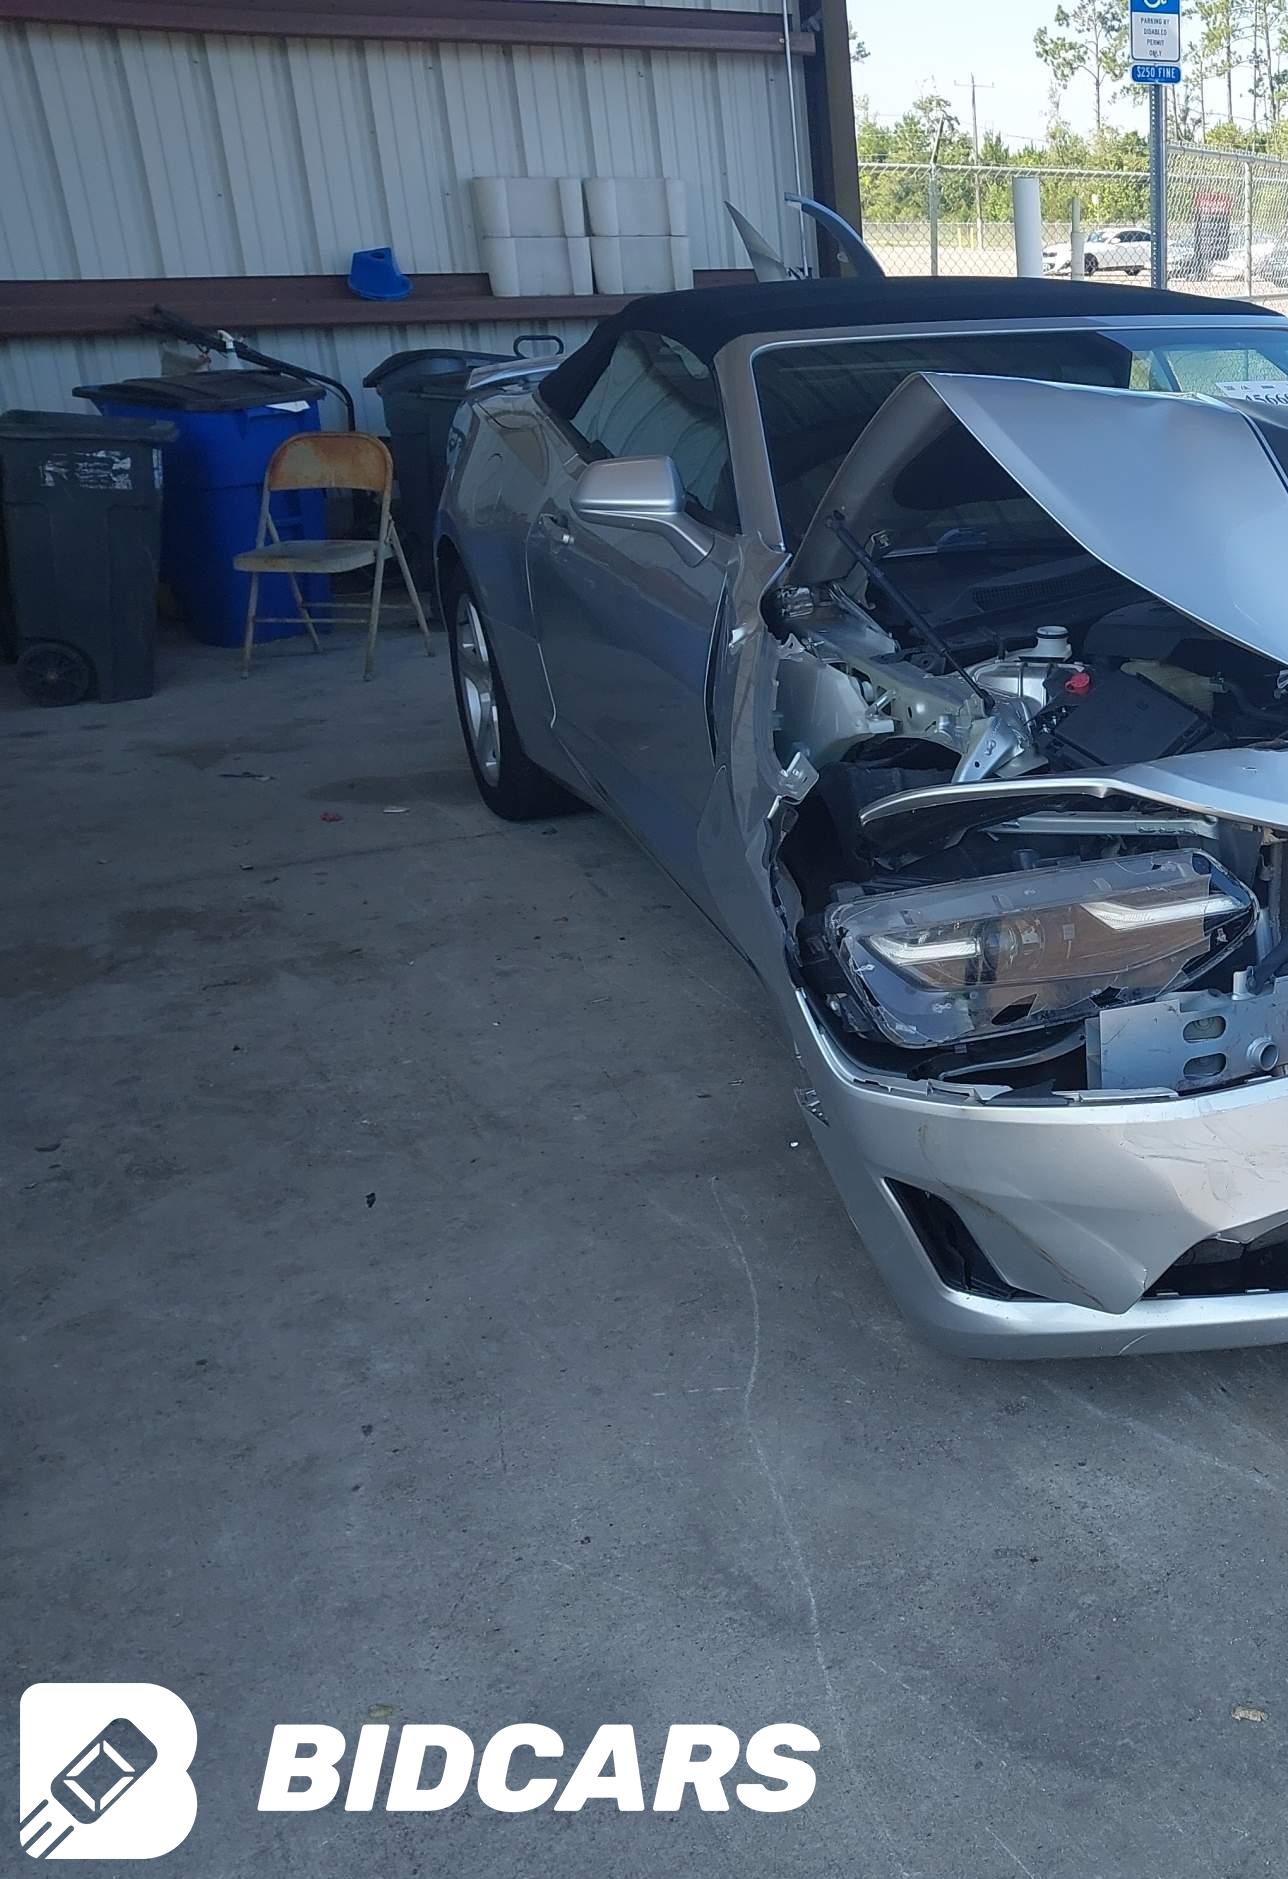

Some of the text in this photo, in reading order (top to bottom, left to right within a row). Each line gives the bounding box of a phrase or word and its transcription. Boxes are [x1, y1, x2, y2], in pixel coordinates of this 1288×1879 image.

[1143, 28, 1167, 36] DISABLED
[1146, 38, 1164, 46] PERMIT
[1148, 49, 1162, 57] ONLY
[1136, 66, 1176, 79] $250 FINE
